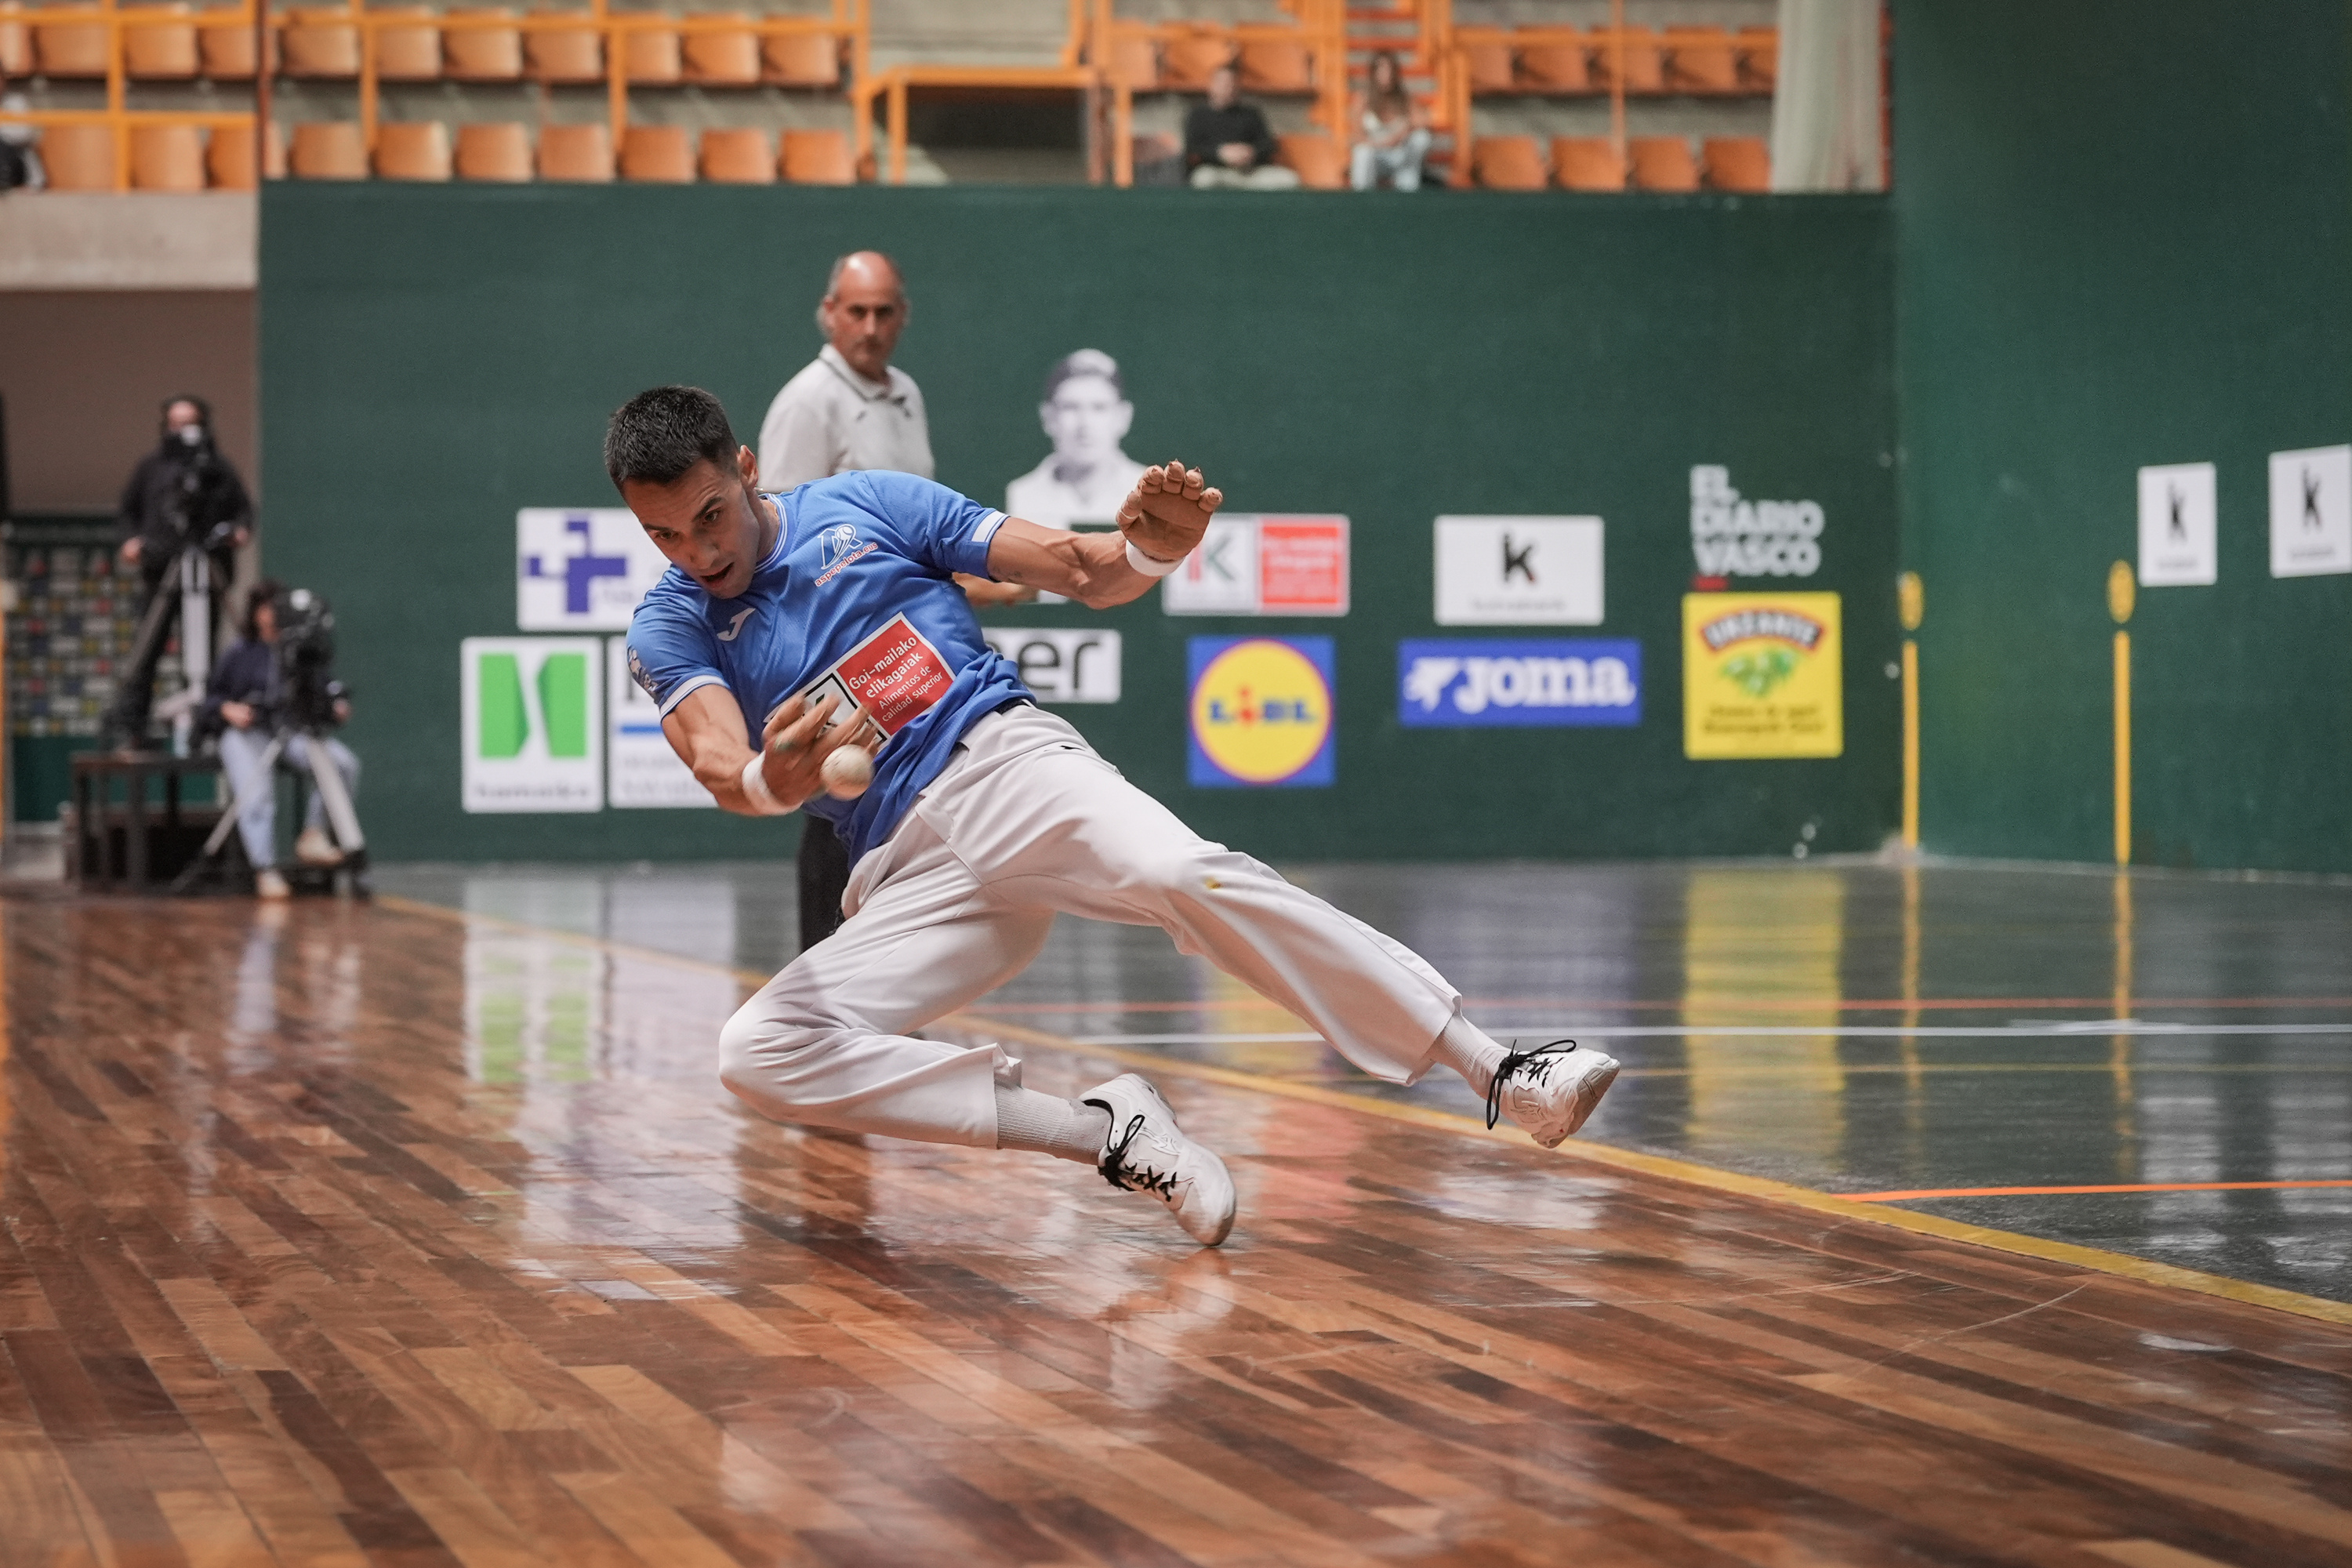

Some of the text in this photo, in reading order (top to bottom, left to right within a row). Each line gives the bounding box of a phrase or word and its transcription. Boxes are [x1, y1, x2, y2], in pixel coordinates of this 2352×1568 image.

[1691, 464, 1740, 500] EL
[1691, 500, 1824, 538] DIARIO
[815, 541, 878, 586] aspepelota.eus
[1693, 536, 1821, 576] VASCO
[848, 636, 917, 690] Goi-mailako
[866, 652, 923, 699] elikagaiak
[878, 666, 931, 710] Alimentos de
[882, 672, 943, 722] calidad superior
